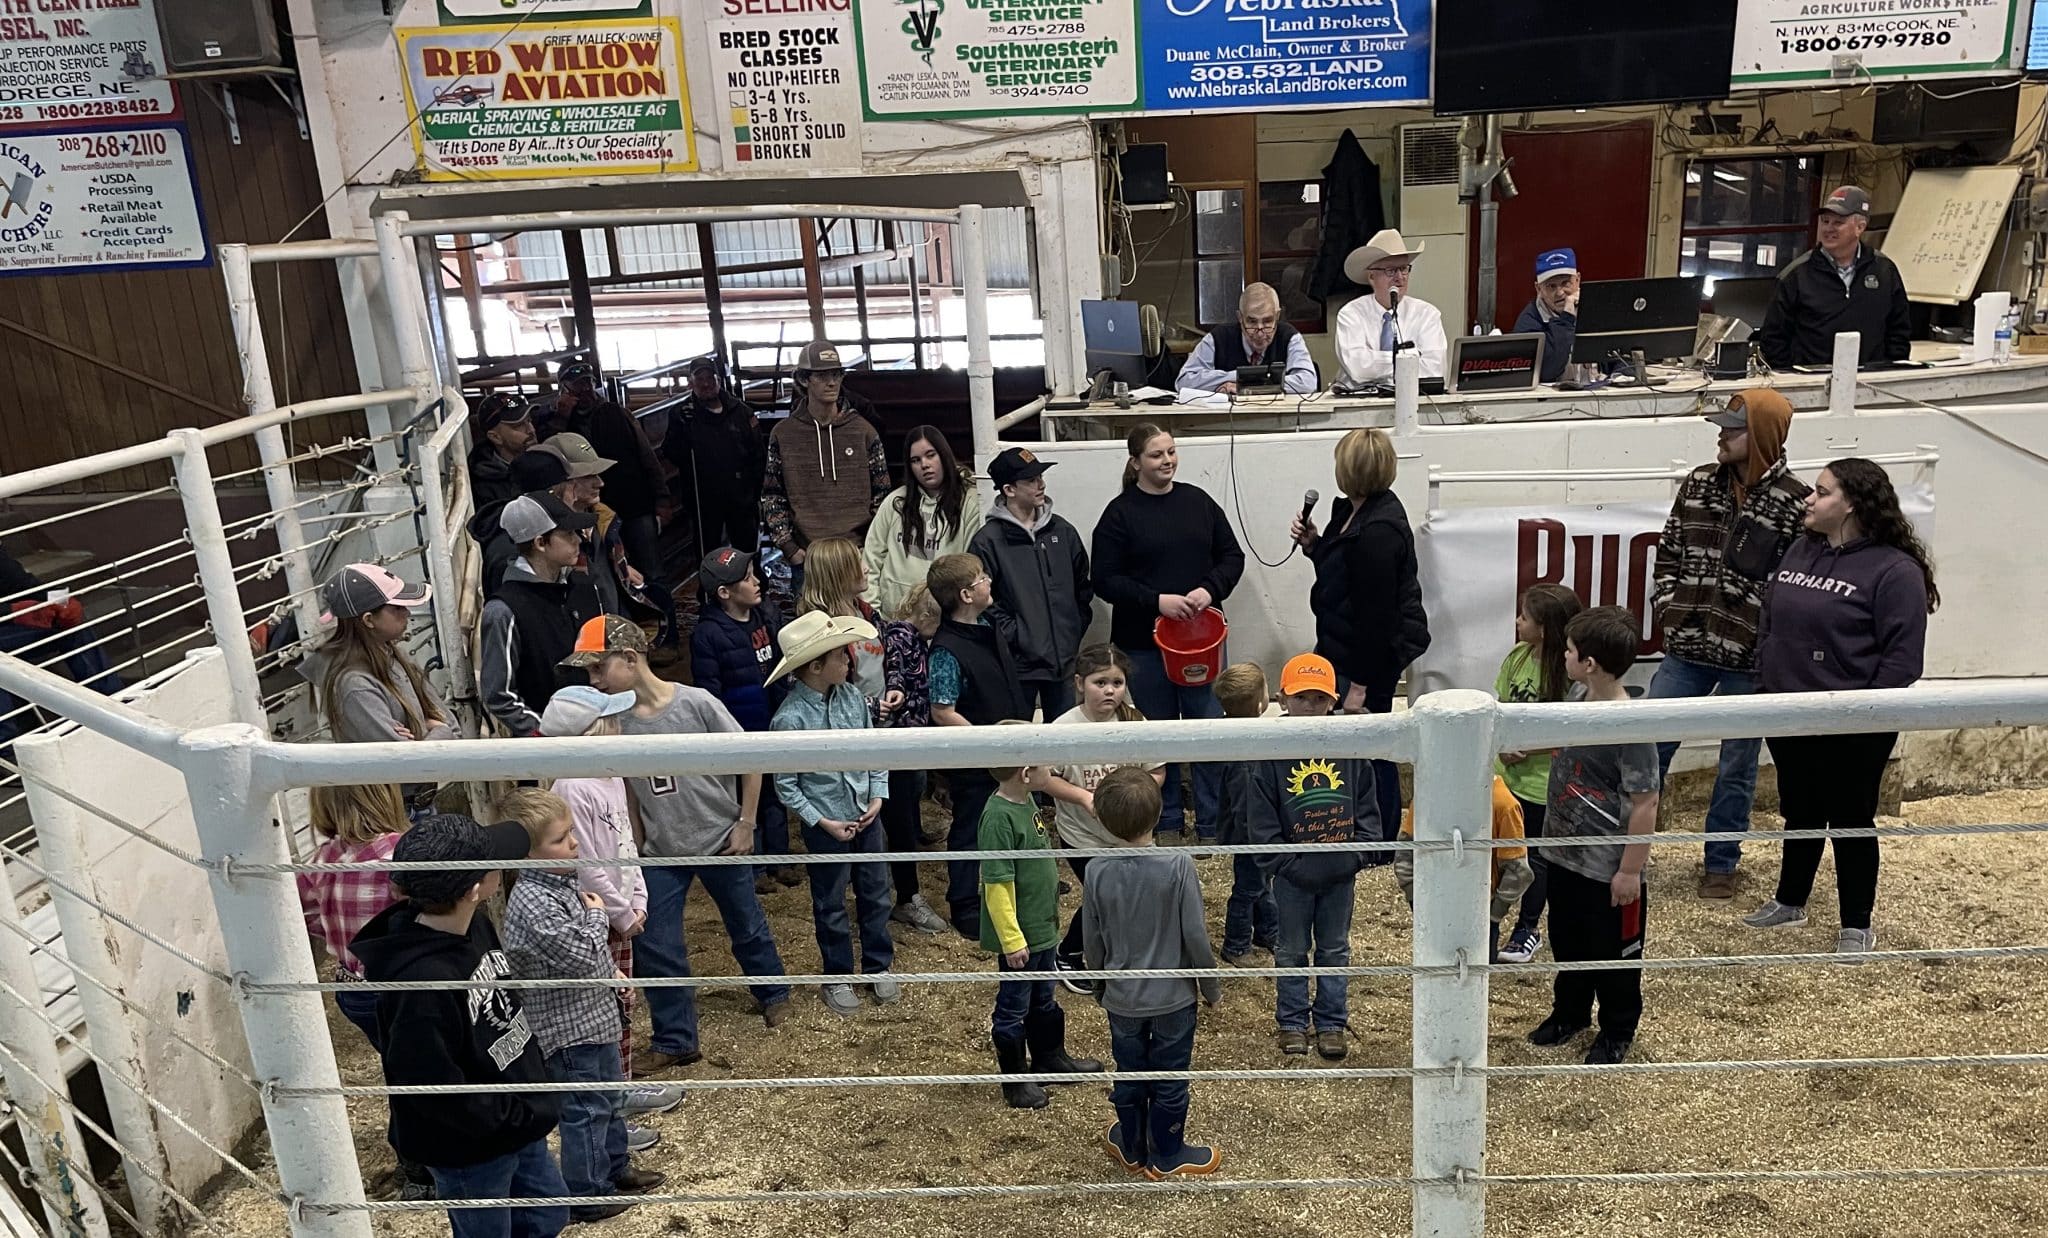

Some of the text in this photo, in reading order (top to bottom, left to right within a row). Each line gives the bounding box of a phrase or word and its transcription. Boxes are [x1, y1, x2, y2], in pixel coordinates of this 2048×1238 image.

[989, 8, 1083, 22] SERVICE
[1800, 1, 1895, 16] AGRICULTURE
[0, 17, 91, 41] SEL, INC.
[988, 26, 1005, 34] 785
[1269, 15, 1391, 32] Land Brokers
[1776, 28, 1789, 37] N.
[1794, 25, 1829, 36] HWY.
[544, 35, 571, 46] GRIFF
[719, 28, 839, 48] BRED STOCK
[17, 43, 105, 59] PERFORMANCE
[110, 41, 147, 54] PARTS
[956, 38, 1118, 60] Southwestern
[1166, 39, 1406, 63] Duane McClain, Owner & Broker
[0, 57, 109, 74] NJECTION SERVICE
[423, 42, 661, 77] RED WILLOW
[740, 48, 822, 67] CLASSES
[968, 56, 1107, 74] VETERINARY
[942, 72, 959, 80] DVM
[986, 71, 1092, 86] SERVICES
[1190, 59, 1384, 82] 308.532.LAND
[502, 71, 666, 102] AVIATION
[728, 72, 747, 87] NO
[882, 83, 908, 92] STEPHEN
[953, 80, 970, 88] DVM
[0, 82, 141, 101] DREGE, NE.
[749, 89, 811, 105] 3-4 Yrs.
[954, 89, 970, 98] DVM
[431, 104, 667, 125] AERIAL SPRAYING WHOLESALE AG
[751, 108, 813, 124] 5-8 Yrs.
[468, 119, 636, 137] CHEMICALS & FERTILIZER
[753, 124, 846, 142] SHORT SOLID
[57, 137, 81, 152] 308
[471, 140, 505, 154] Done
[508, 139, 525, 154] By
[577, 136, 601, 149] Our
[754, 143, 811, 160] BROKEN
[100, 173, 136, 184] USDA
[88, 184, 153, 197] Processing
[88, 200, 163, 213] Retail Meat
[100, 213, 157, 225] Available
[44, 230, 64, 240] LLC
[90, 225, 173, 239] Credit Cards
[18, 243, 40, 255] City,
[41, 242, 55, 252] NE
[104, 236, 165, 248] Accepted
[11, 255, 55, 267] Supporting
[58, 252, 93, 264] Farming
[96, 251, 102, 261] &
[106, 249, 145, 261] Ranching
[1777, 570, 1858, 597] CARHARTT
[1308, 822, 1325, 832] this
